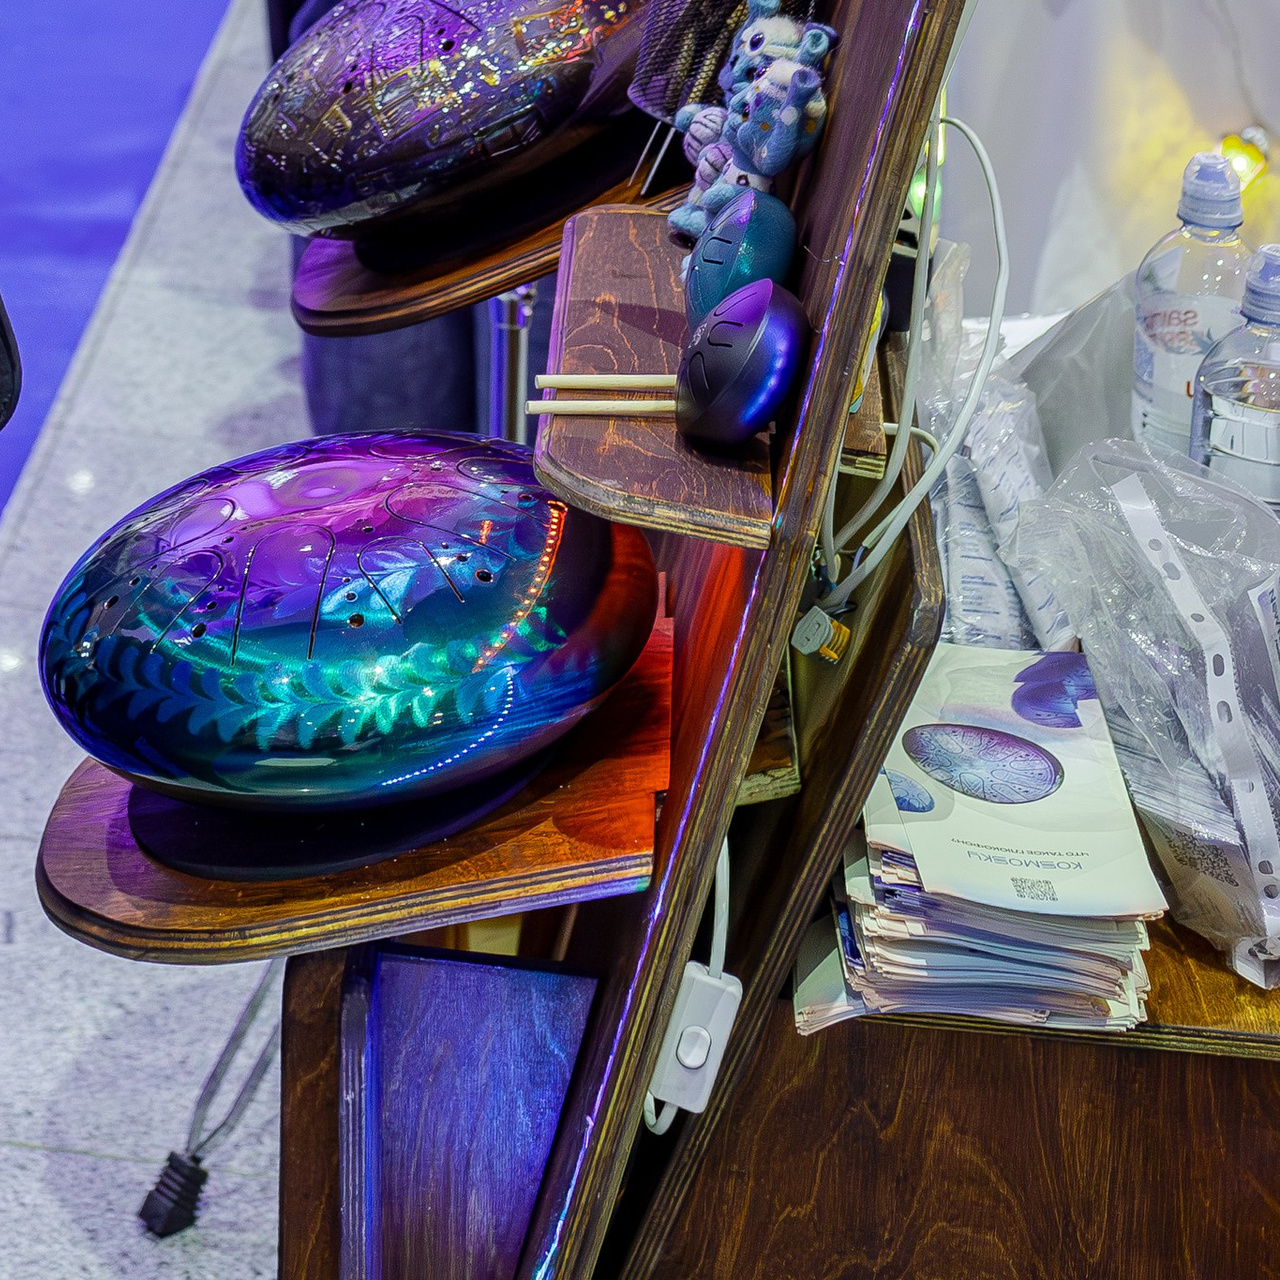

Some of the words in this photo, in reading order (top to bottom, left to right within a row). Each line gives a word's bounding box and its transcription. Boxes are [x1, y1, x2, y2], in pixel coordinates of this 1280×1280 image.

[950, 837, 1025, 856] ГЛЮКОФОН?
[1026, 849, 1063, 857] ТАКОЕ
[966, 850, 1083, 870] KOSMOSKY
